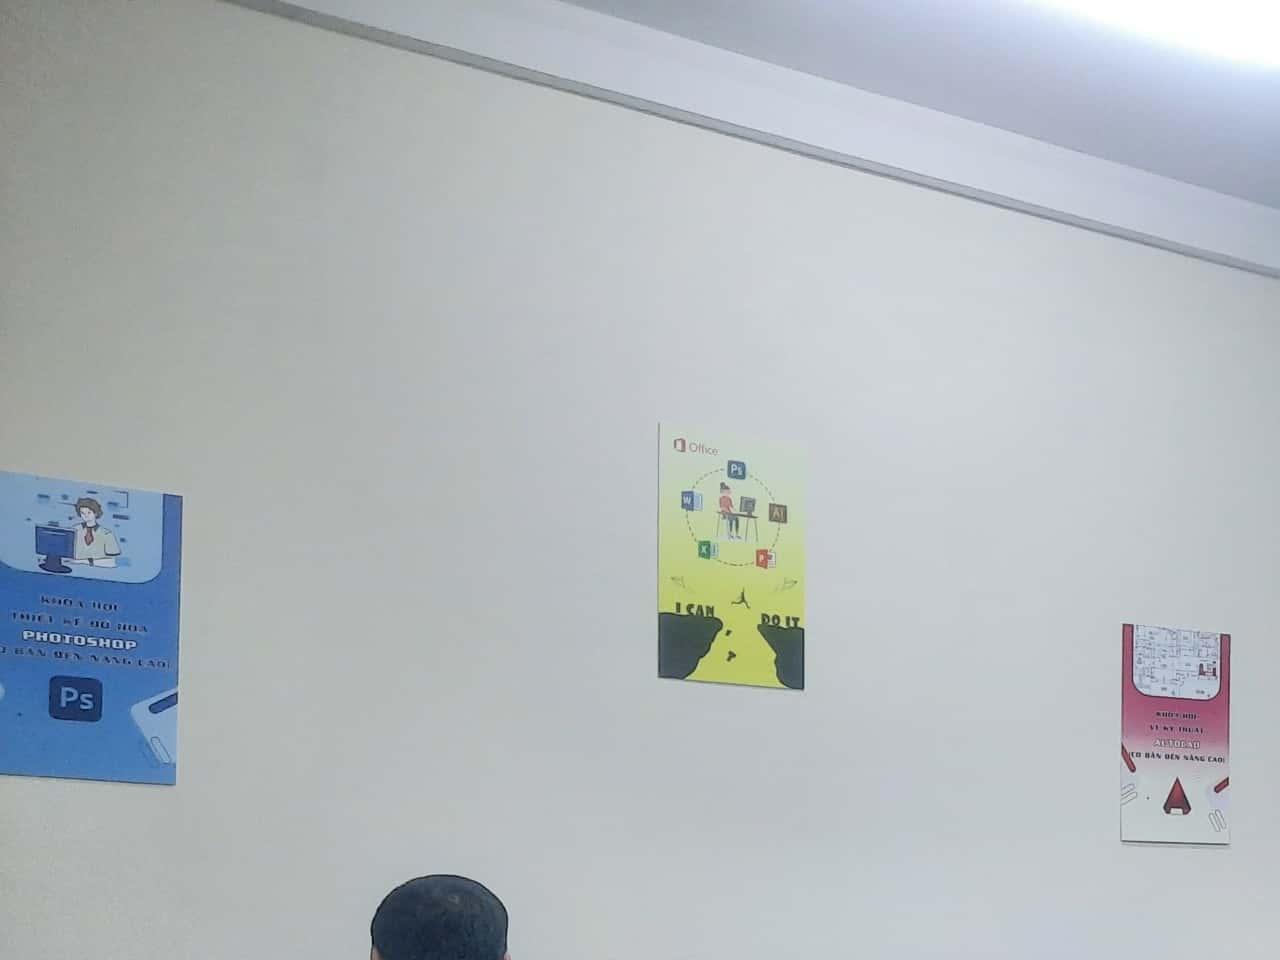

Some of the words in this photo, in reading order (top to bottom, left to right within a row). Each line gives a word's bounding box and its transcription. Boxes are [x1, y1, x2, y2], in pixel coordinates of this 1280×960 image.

[686, 603, 715, 618] CAN
[761, 613, 781, 627] DO
[22, 629, 137, 650] PHOTOSHOP
[60, 686, 94, 711] Ps
